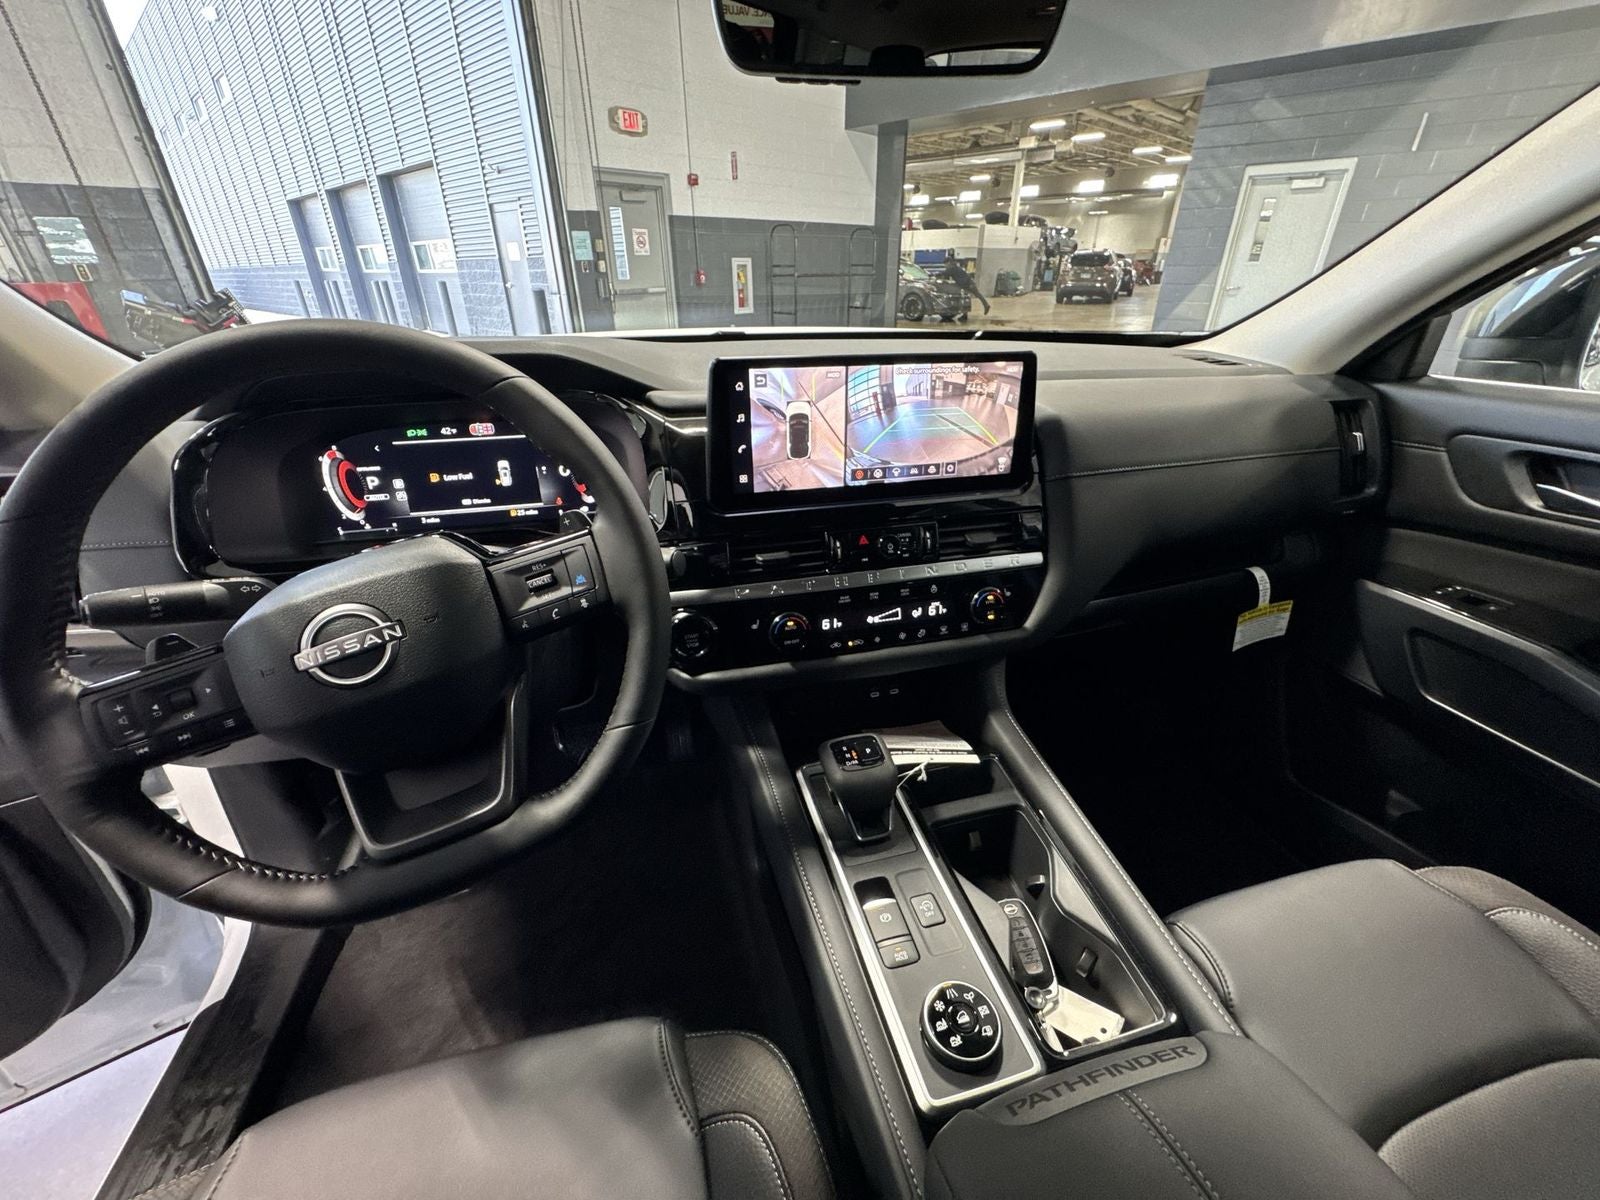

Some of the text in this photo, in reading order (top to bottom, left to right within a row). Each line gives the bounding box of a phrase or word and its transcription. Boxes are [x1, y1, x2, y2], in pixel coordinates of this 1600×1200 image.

[622, 111, 639, 129] EXIT
[914, 366, 951, 375] surroundings
[365, 476, 380, 490] P
[528, 575, 552, 588] CANCEL
[297, 624, 403, 669] NISSAN
[1004, 1044, 1197, 1117] PATHFINDER
